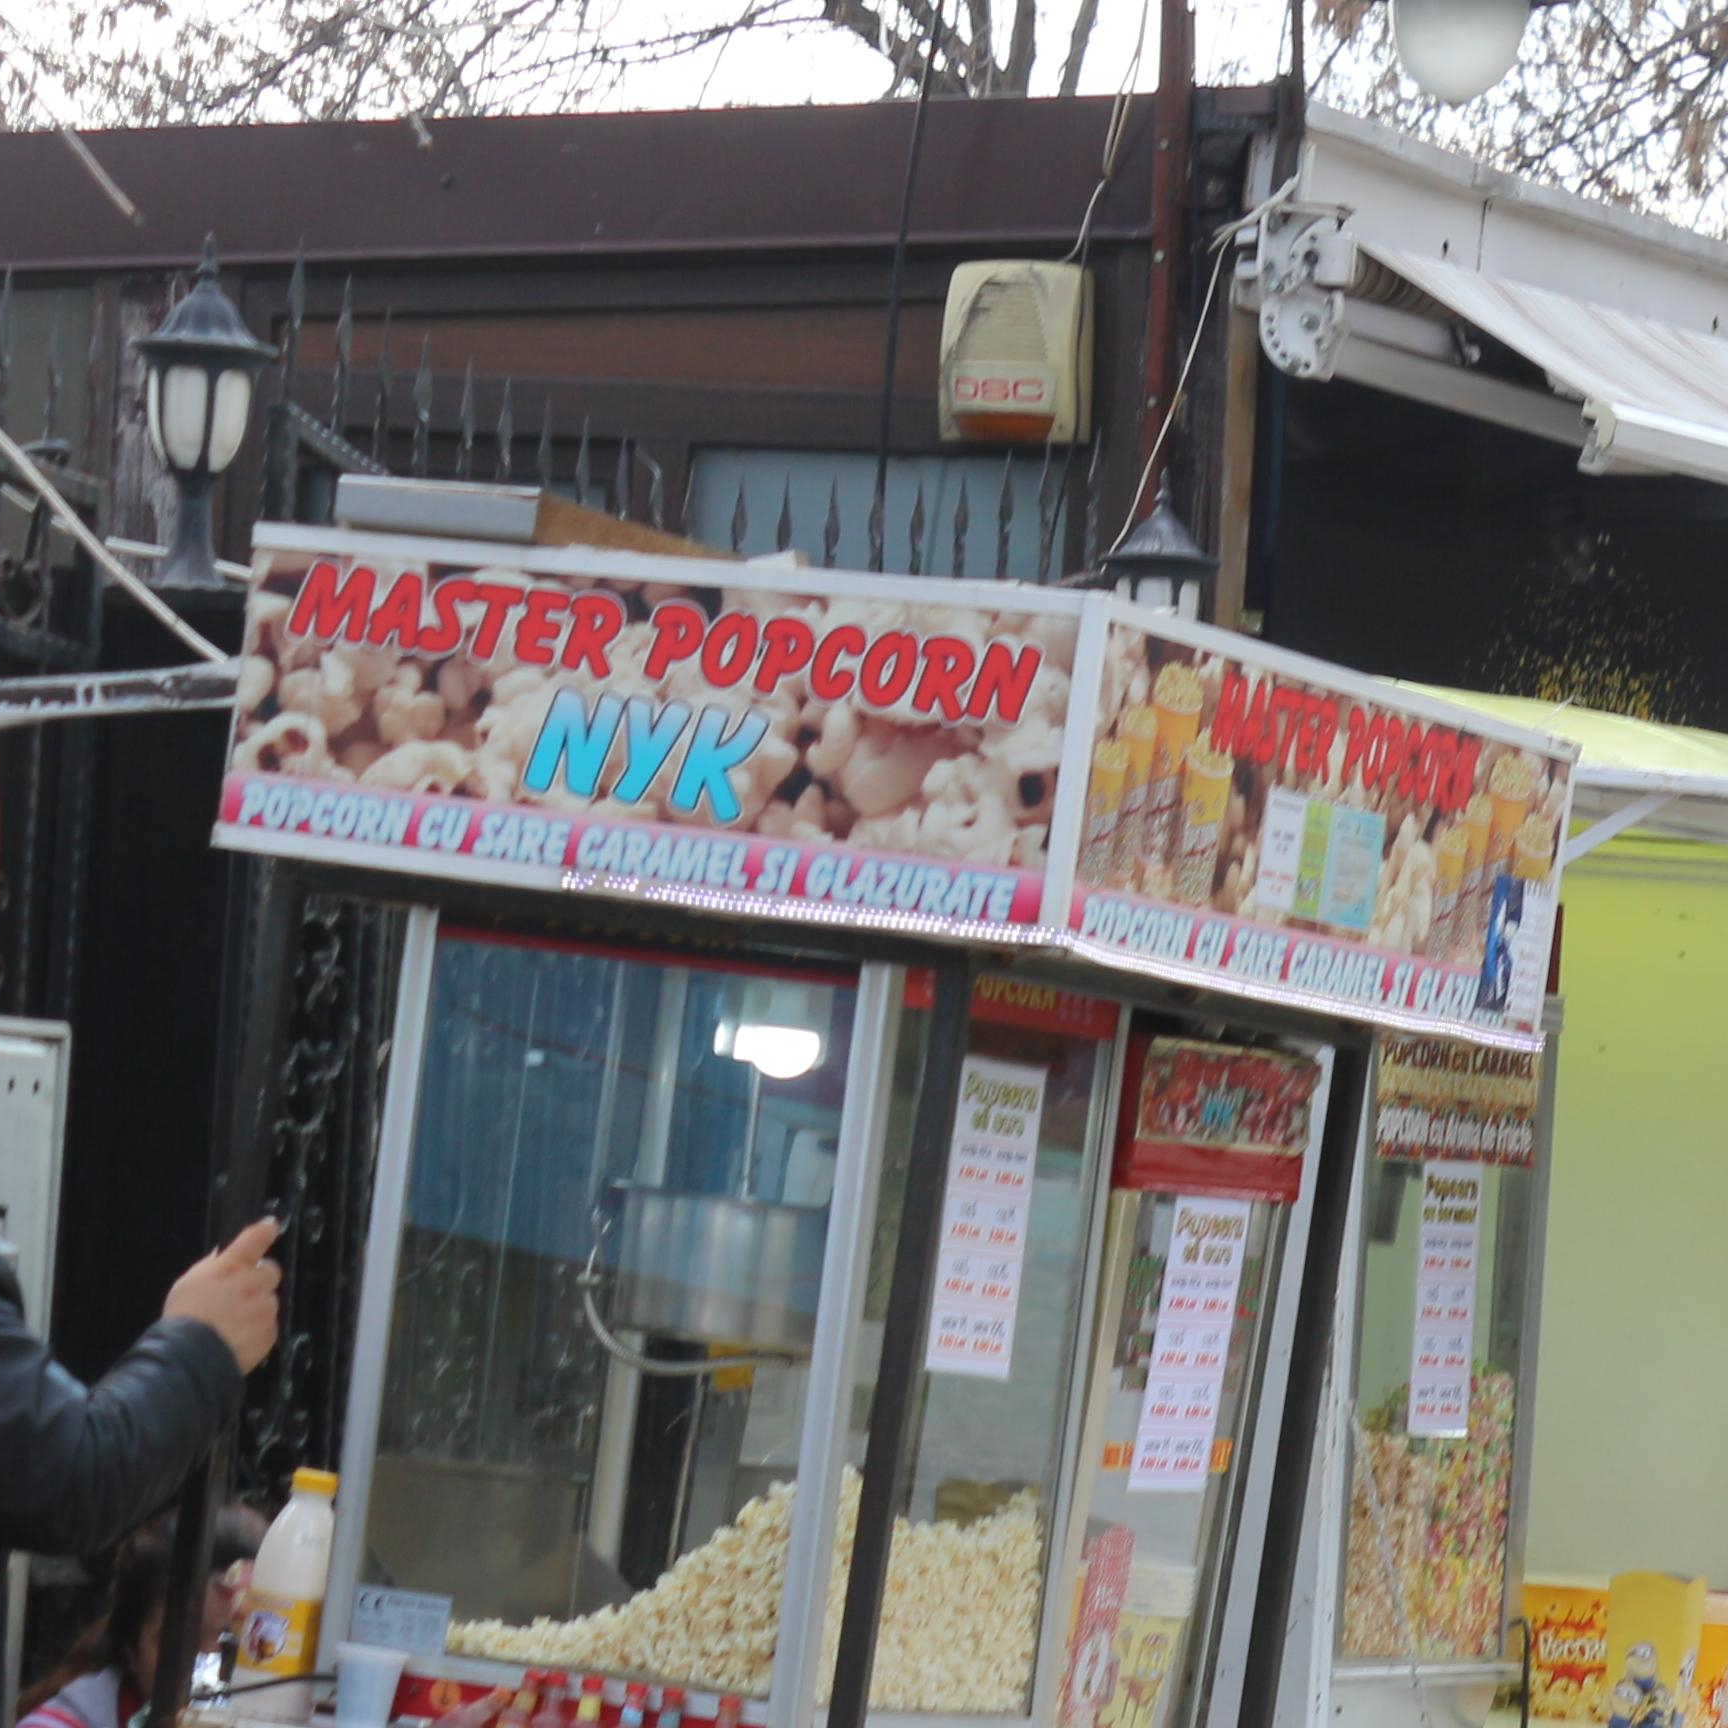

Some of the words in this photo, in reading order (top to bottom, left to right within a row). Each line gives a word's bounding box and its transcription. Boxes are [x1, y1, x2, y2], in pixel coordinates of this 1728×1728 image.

[954, 376, 1045, 402] DSC
[288, 560, 626, 679] MASTER
[643, 602, 1043, 725] POPCORN
[523, 687, 770, 824] NYK
[1210, 671, 1339, 785] MASTER
[1341, 705, 1482, 816] POPCORN
[237, 779, 415, 845] POPCORN
[416, 804, 473, 852] CU
[472, 811, 572, 866] SARE
[576, 825, 749, 887] CARAMEL
[754, 849, 800, 895] SI
[805, 852, 1020, 921] GLAZURATE
[1080, 895, 1194, 962] POPCORN
[1194, 919, 1231, 967] CU
[1228, 928, 1288, 982] SARE
[1287, 939, 1386, 999] CARAMEL
[1385, 958, 1418, 1007] SI
[962, 1072, 1039, 1114] Popcorn
[1382, 1038, 1452, 1071] POPCORN
[1472, 1044, 1534, 1080] CARAMEL
[1175, 1207, 1245, 1241] Popcorn
